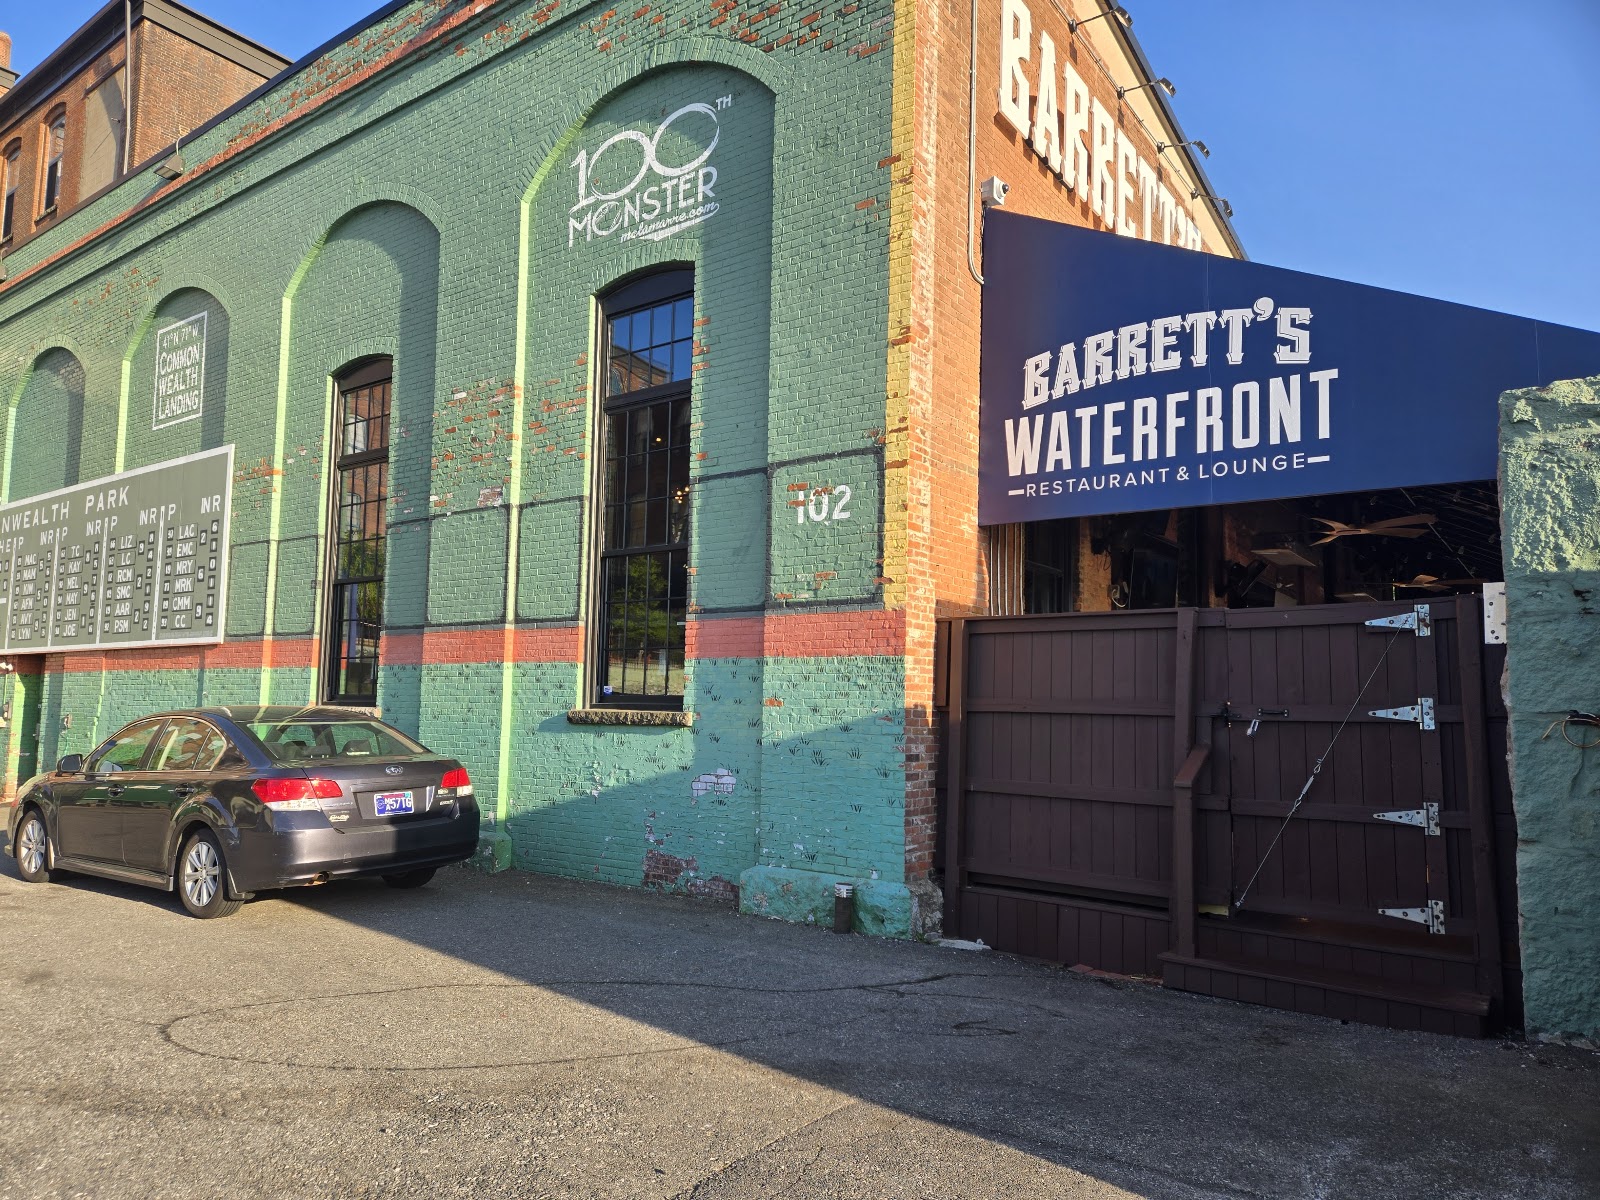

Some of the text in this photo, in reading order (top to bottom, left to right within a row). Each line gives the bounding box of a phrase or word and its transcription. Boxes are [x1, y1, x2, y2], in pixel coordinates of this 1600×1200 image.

[569, 94, 732, 213] 100 TH
[568, 166, 718, 248] MONSTER
[160, 342, 201, 375] COMMON
[1022, 297, 1313, 411] BARRETT'S
[159, 365, 199, 397] WEALTH
[159, 390, 199, 420] LANDING
[1004, 368, 1339, 477] WATERFRONT
[1027, 452, 1306, 497] RESTAURANT & LOUNGE
[1, 485, 130, 534] NWEALTH PARK
[179, 524, 195, 539] LAC
[121, 535, 133, 549] LIZ
[177, 542, 193, 557] EMC
[71, 545, 80, 558] TC
[121, 552, 131, 566] LC
[118, 568, 132, 582] RCM
[176, 560, 193, 575] MRY
[117, 586, 130, 599] SMC
[174, 578, 192, 593] MRK
[115, 603, 130, 616] AAR
[172, 596, 190, 610] CMM
[65, 608, 77, 621] JEN
[175, 615, 186, 628] CC
[63, 624, 76, 636] JOE
[114, 620, 129, 633] PSM
